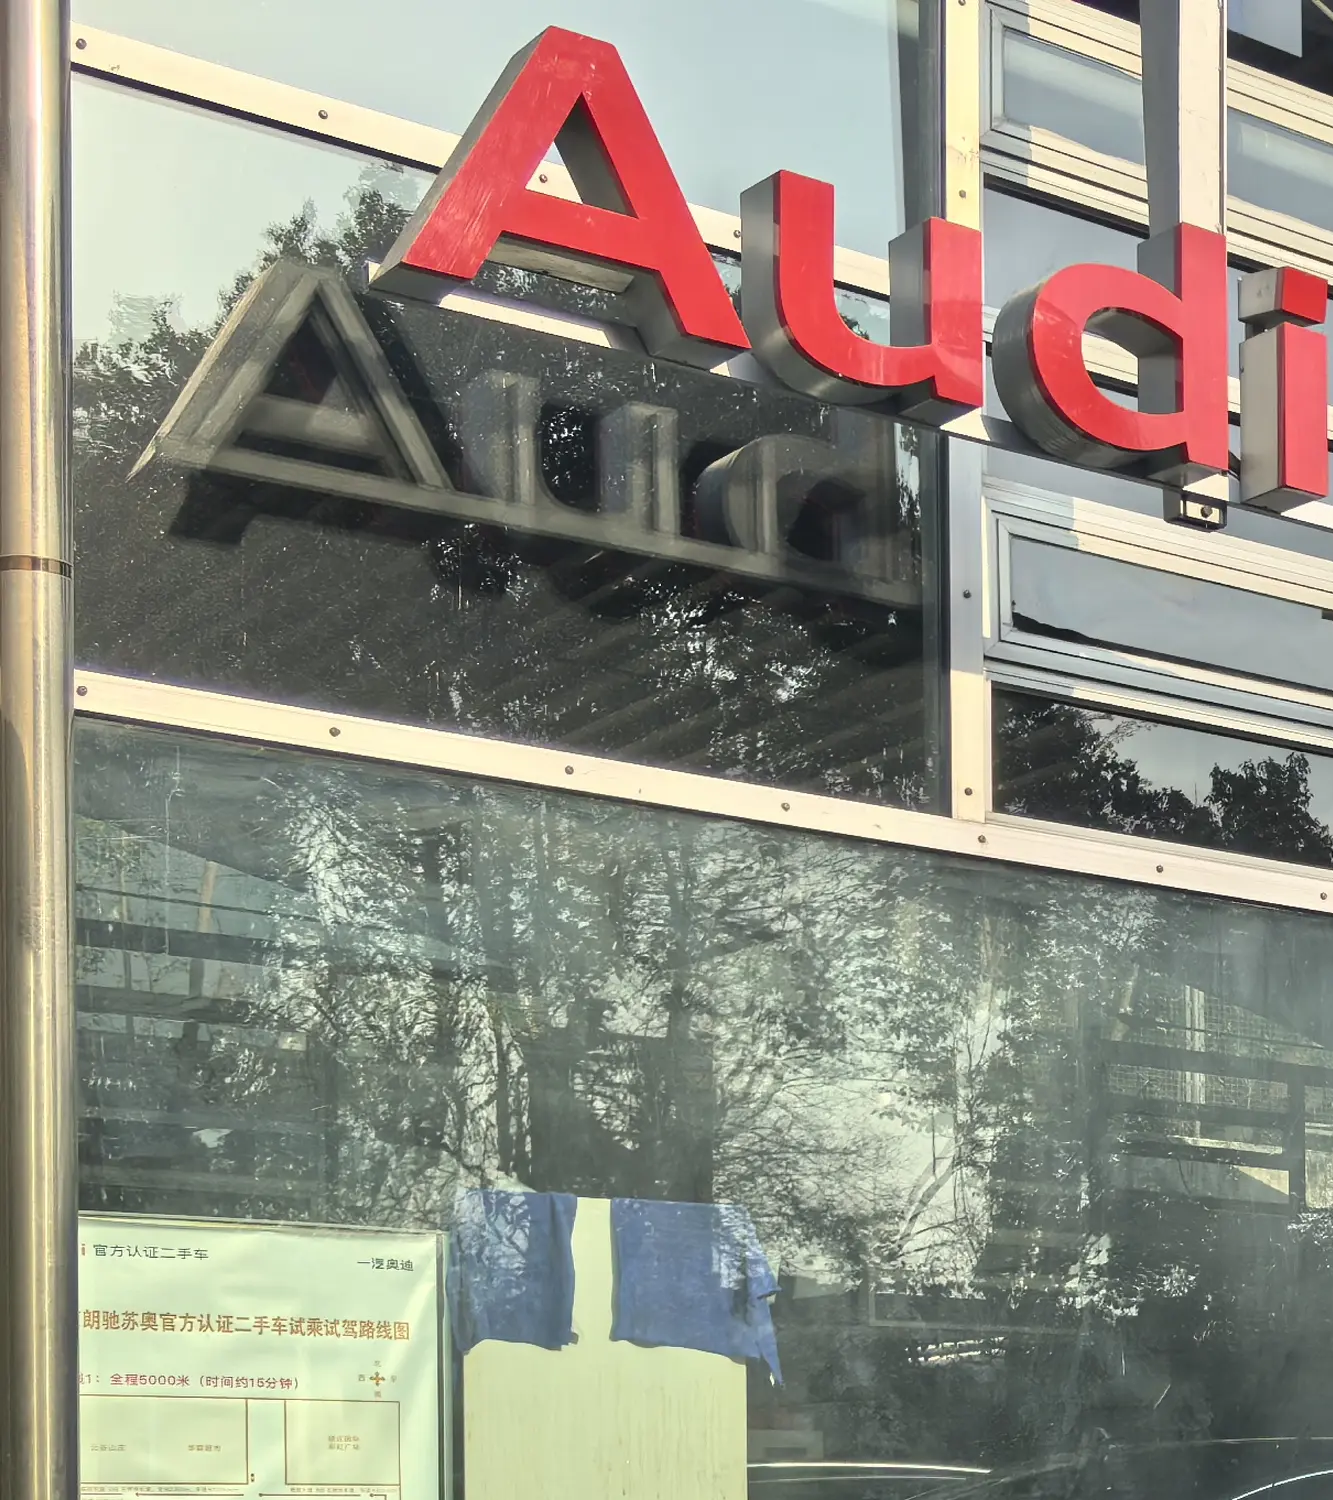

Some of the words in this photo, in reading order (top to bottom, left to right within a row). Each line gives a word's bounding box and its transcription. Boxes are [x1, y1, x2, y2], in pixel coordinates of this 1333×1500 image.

[370, 25, 1328, 510] Audi
[93, 1243, 210, 1260] 官方认证二手车
[356, 1257, 414, 1271] 一汽奥迪
[79, 1309, 410, 1341] 朗驰苏奥官方认证二手车试乘试驾路线图
